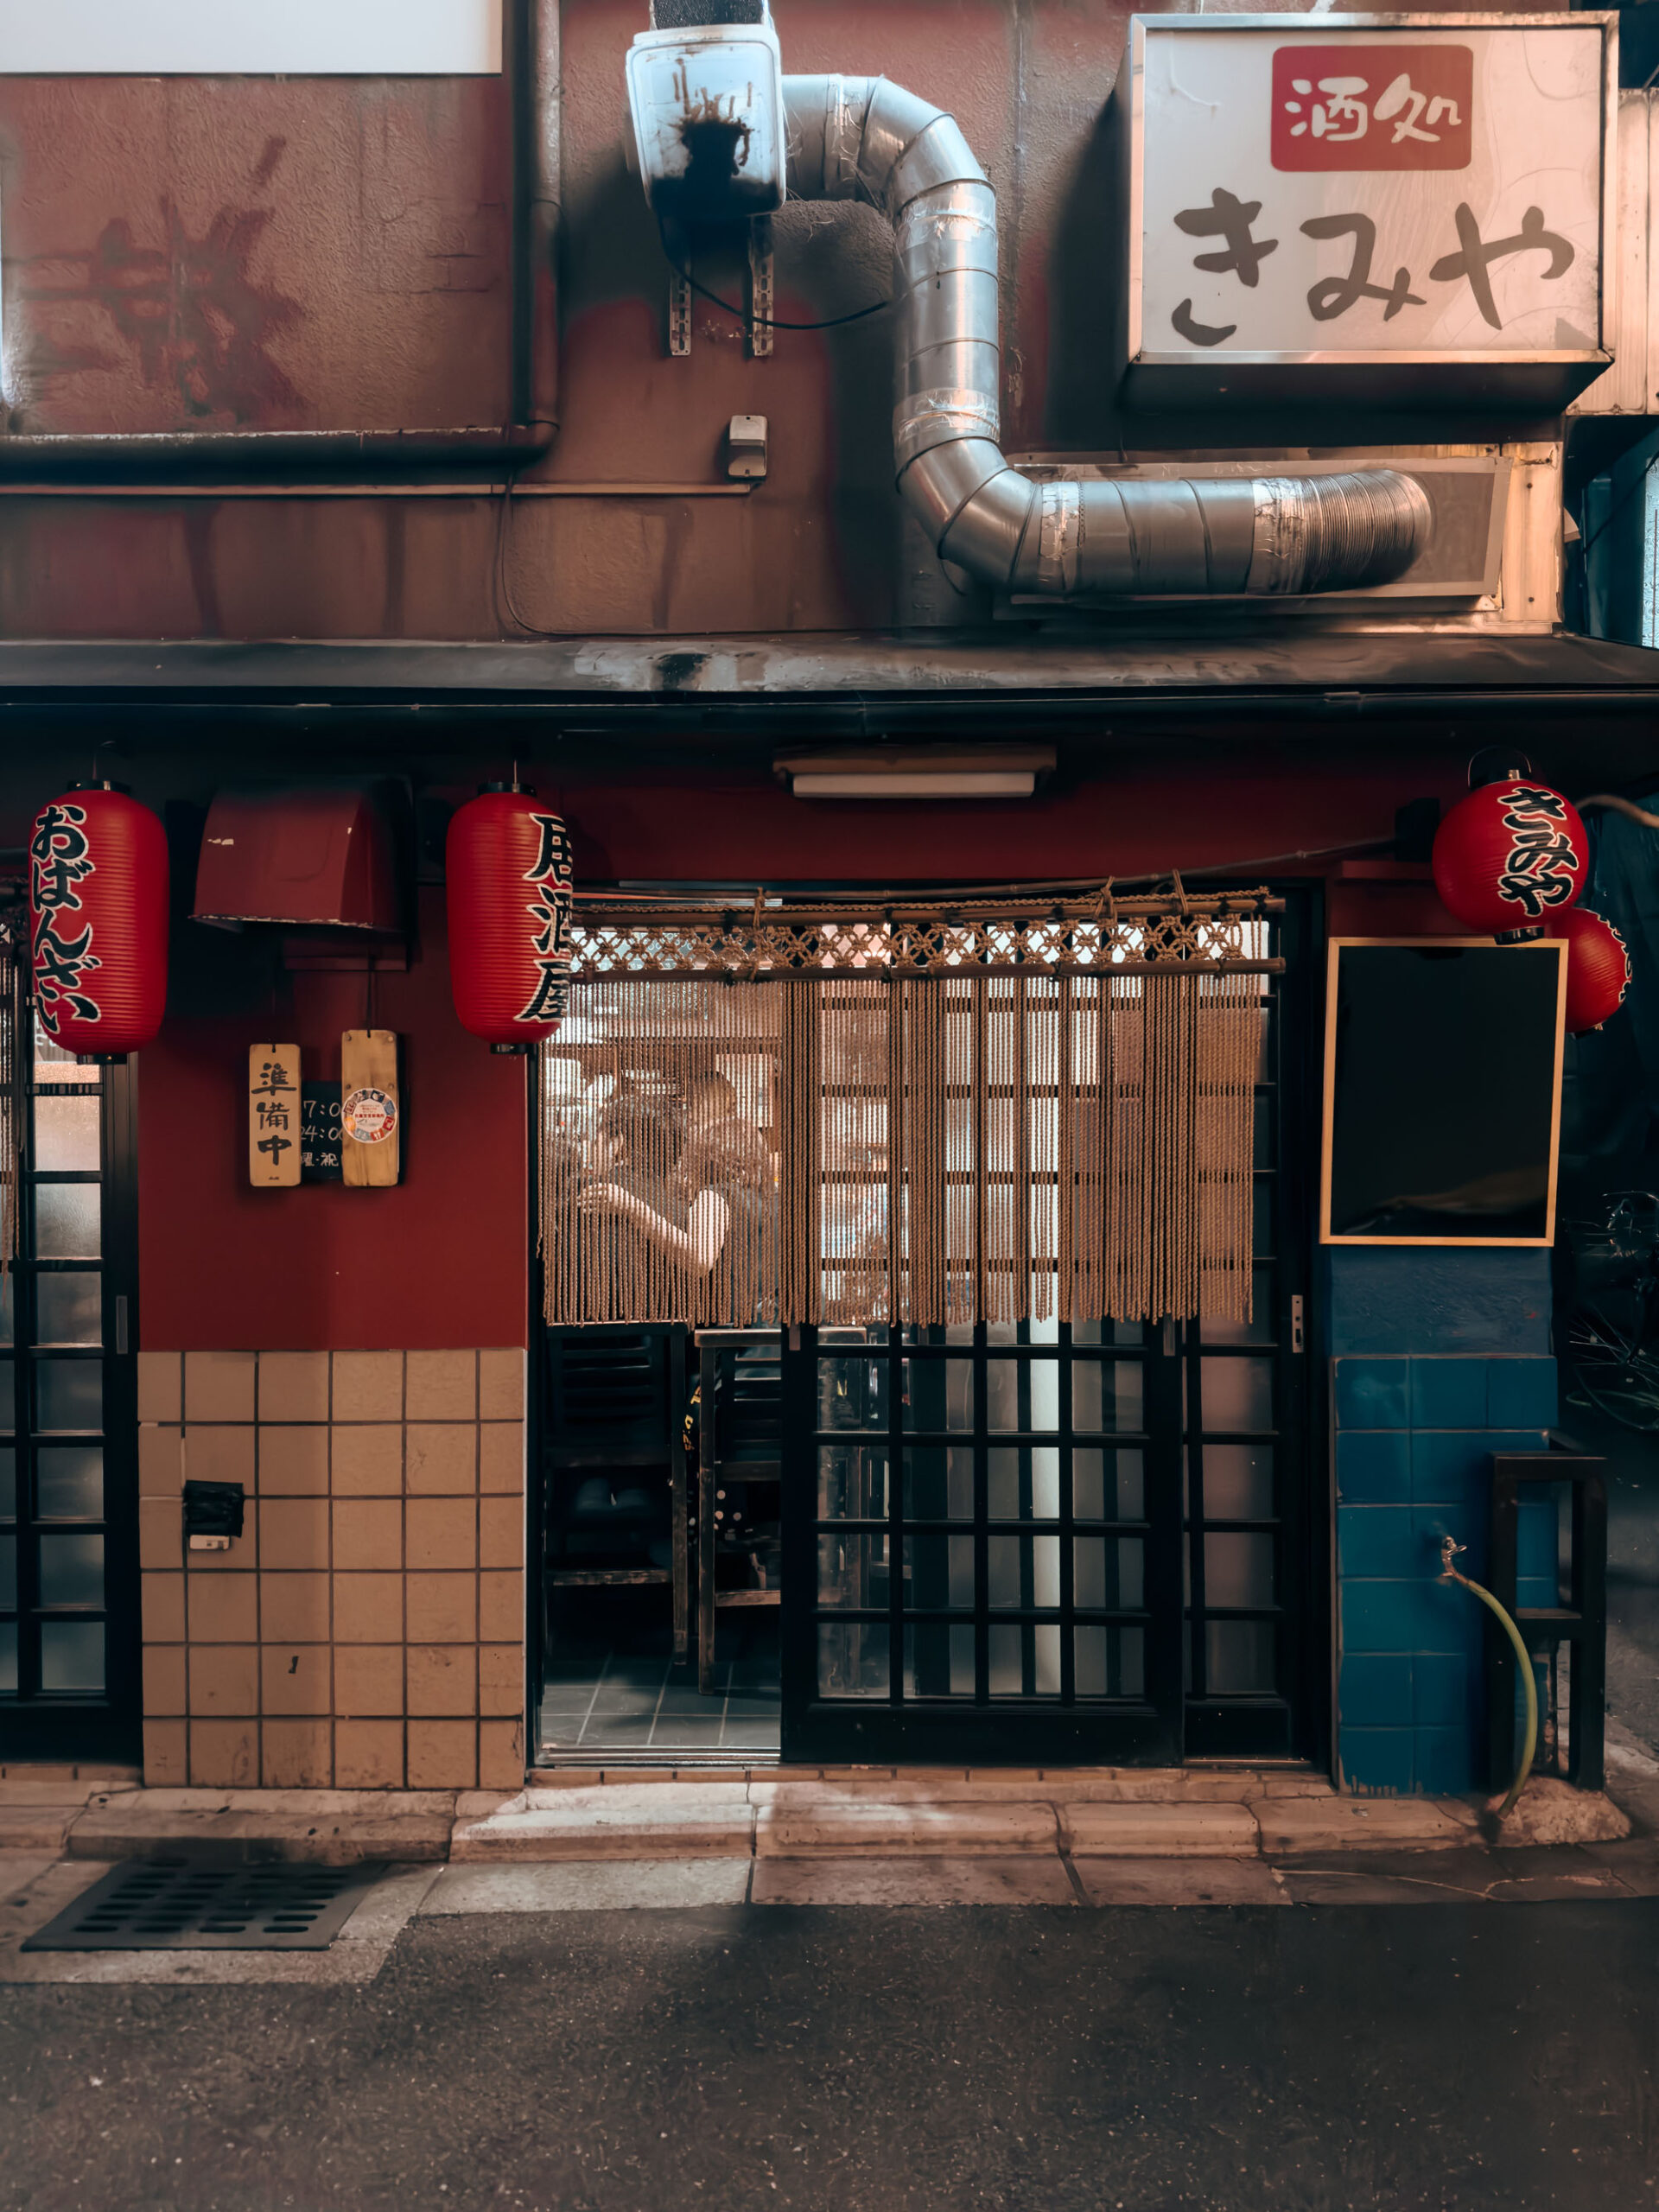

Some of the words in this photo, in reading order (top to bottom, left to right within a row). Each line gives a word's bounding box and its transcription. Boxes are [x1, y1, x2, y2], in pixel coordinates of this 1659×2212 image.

[1284, 73, 1462, 143] 酒処
[1171, 187, 1575, 346] きみや
[31, 804, 103, 1034] おばんざい
[512, 811, 574, 1025] 居酒屋
[1497, 786, 1579, 918] きみや
[251, 1062, 297, 1166] 準備中
